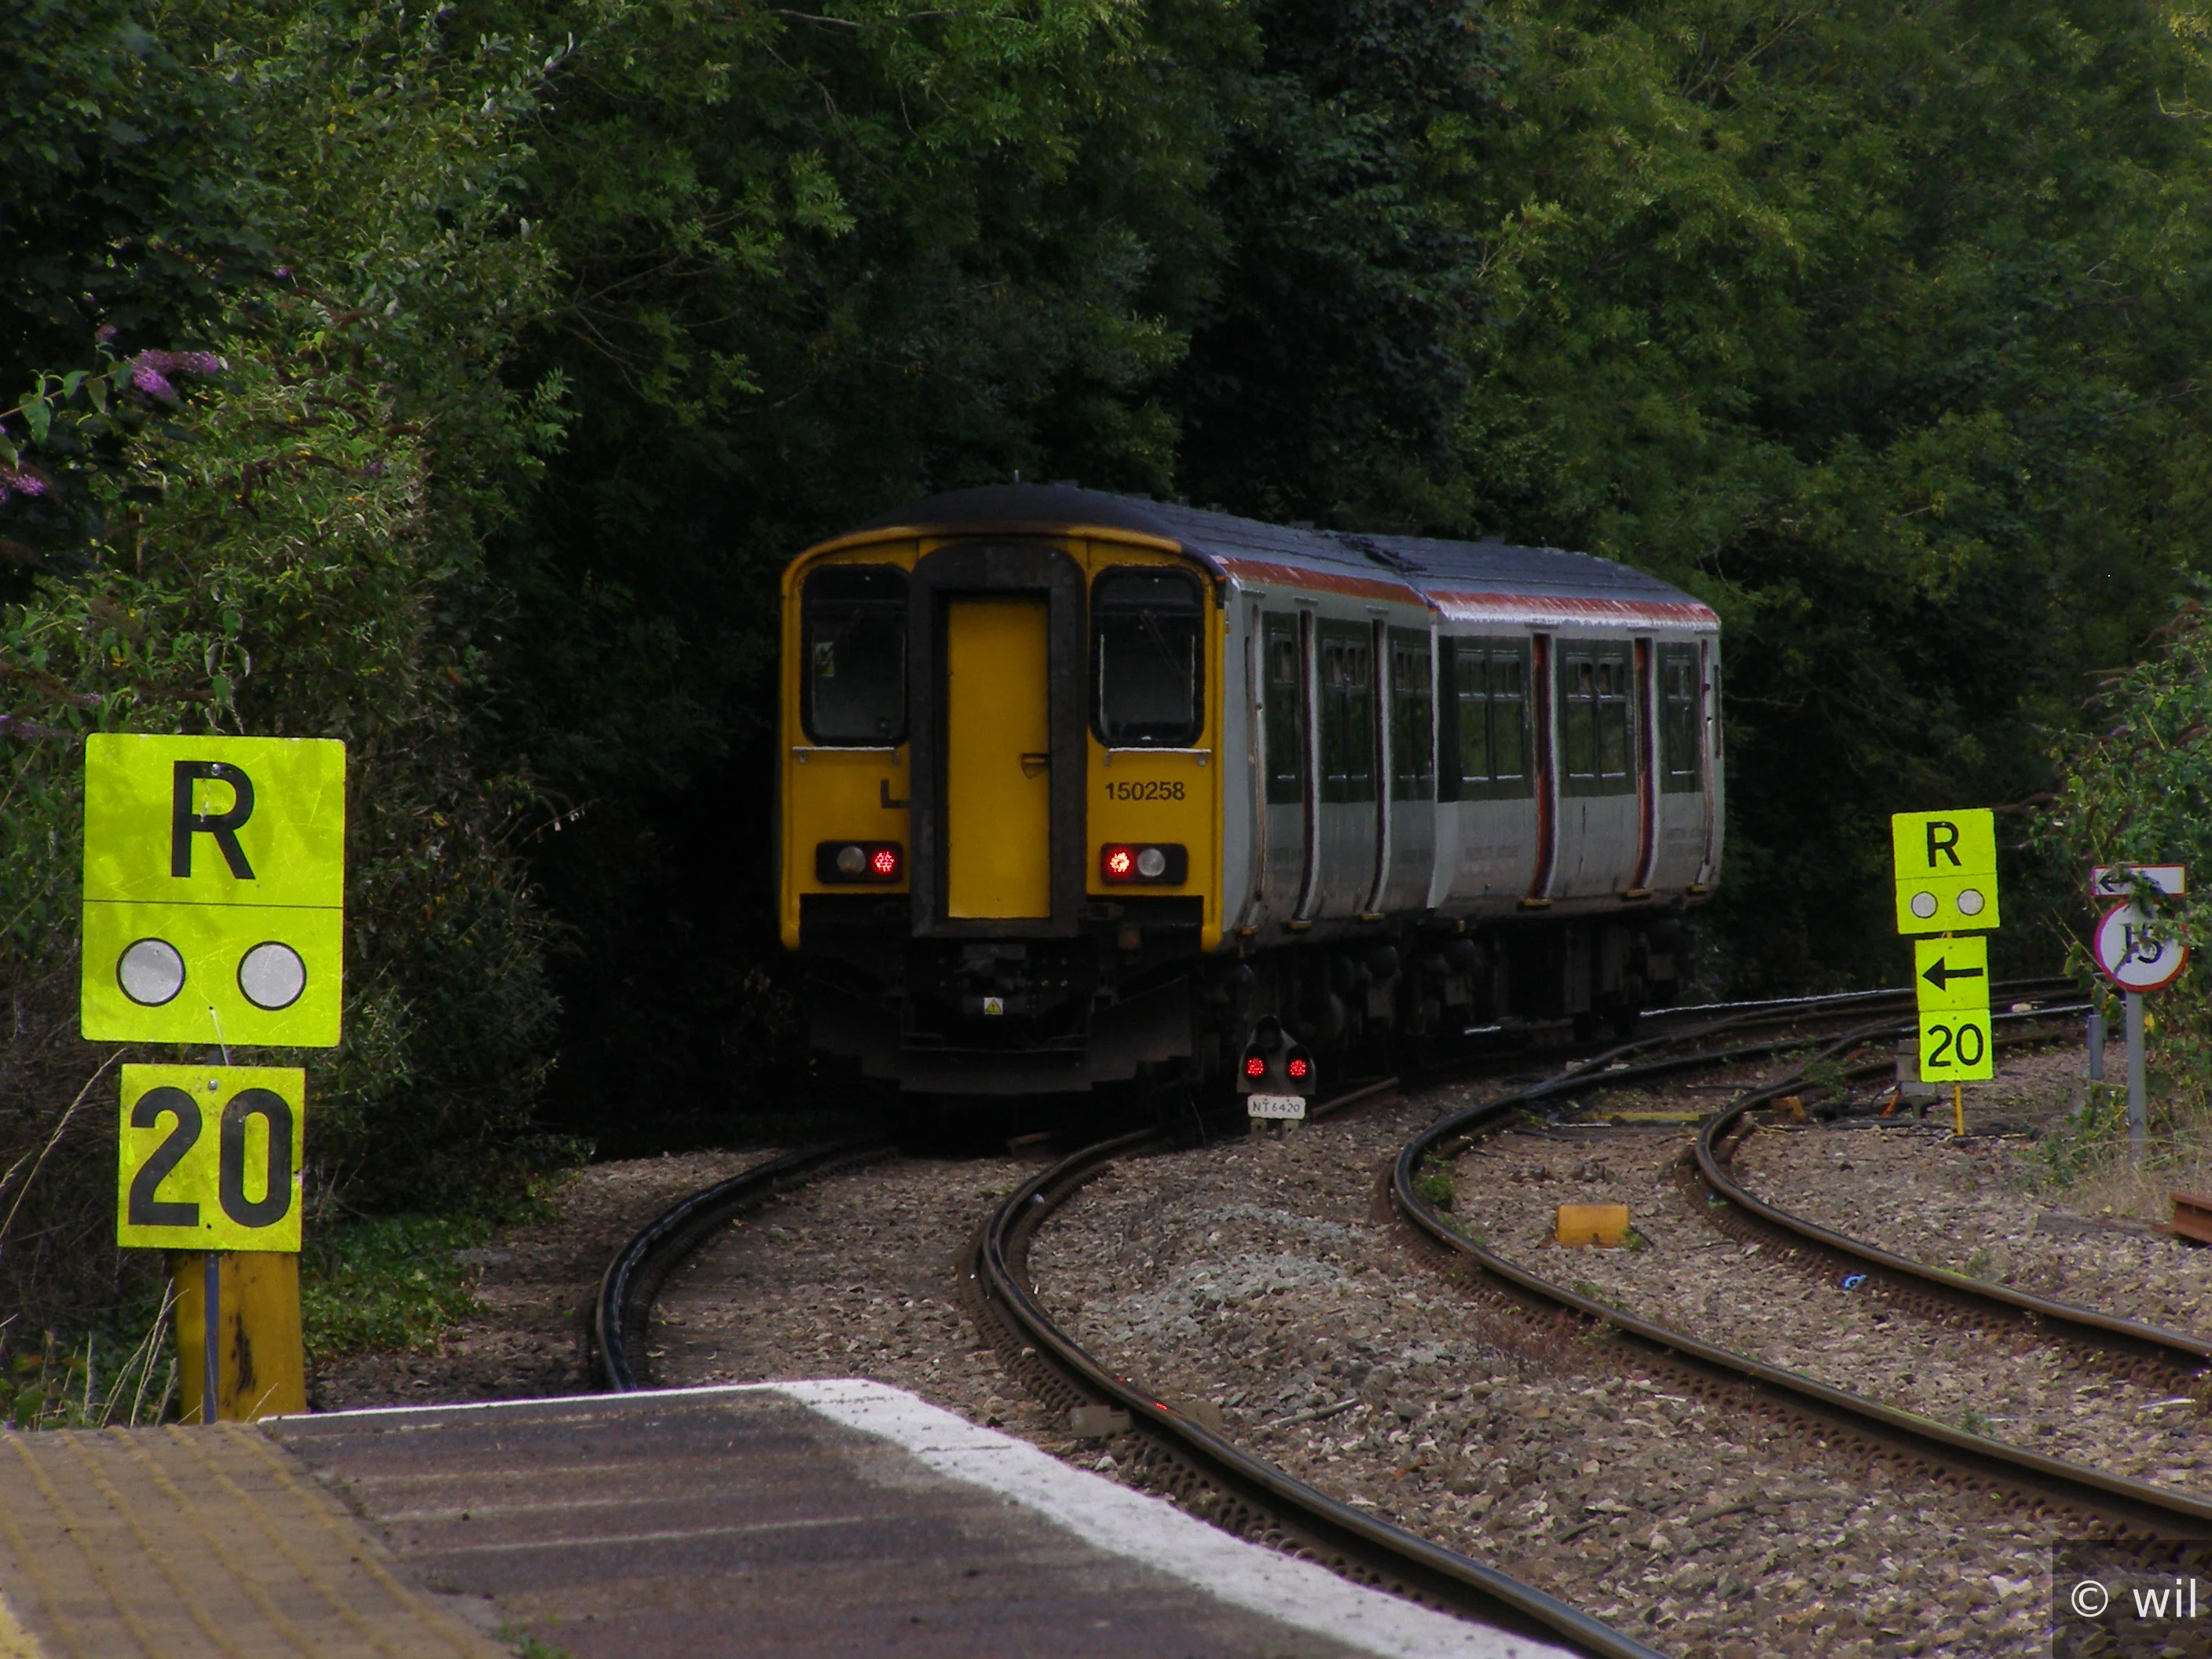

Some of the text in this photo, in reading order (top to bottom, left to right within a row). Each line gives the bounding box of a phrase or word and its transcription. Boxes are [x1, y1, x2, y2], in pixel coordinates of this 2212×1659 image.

[1105, 782, 1186, 802] 150258
[171, 760, 256, 881] R
[1926, 821, 1962, 867] R
[1927, 1024, 1984, 1068] 20
[128, 1086, 294, 1228] 20
